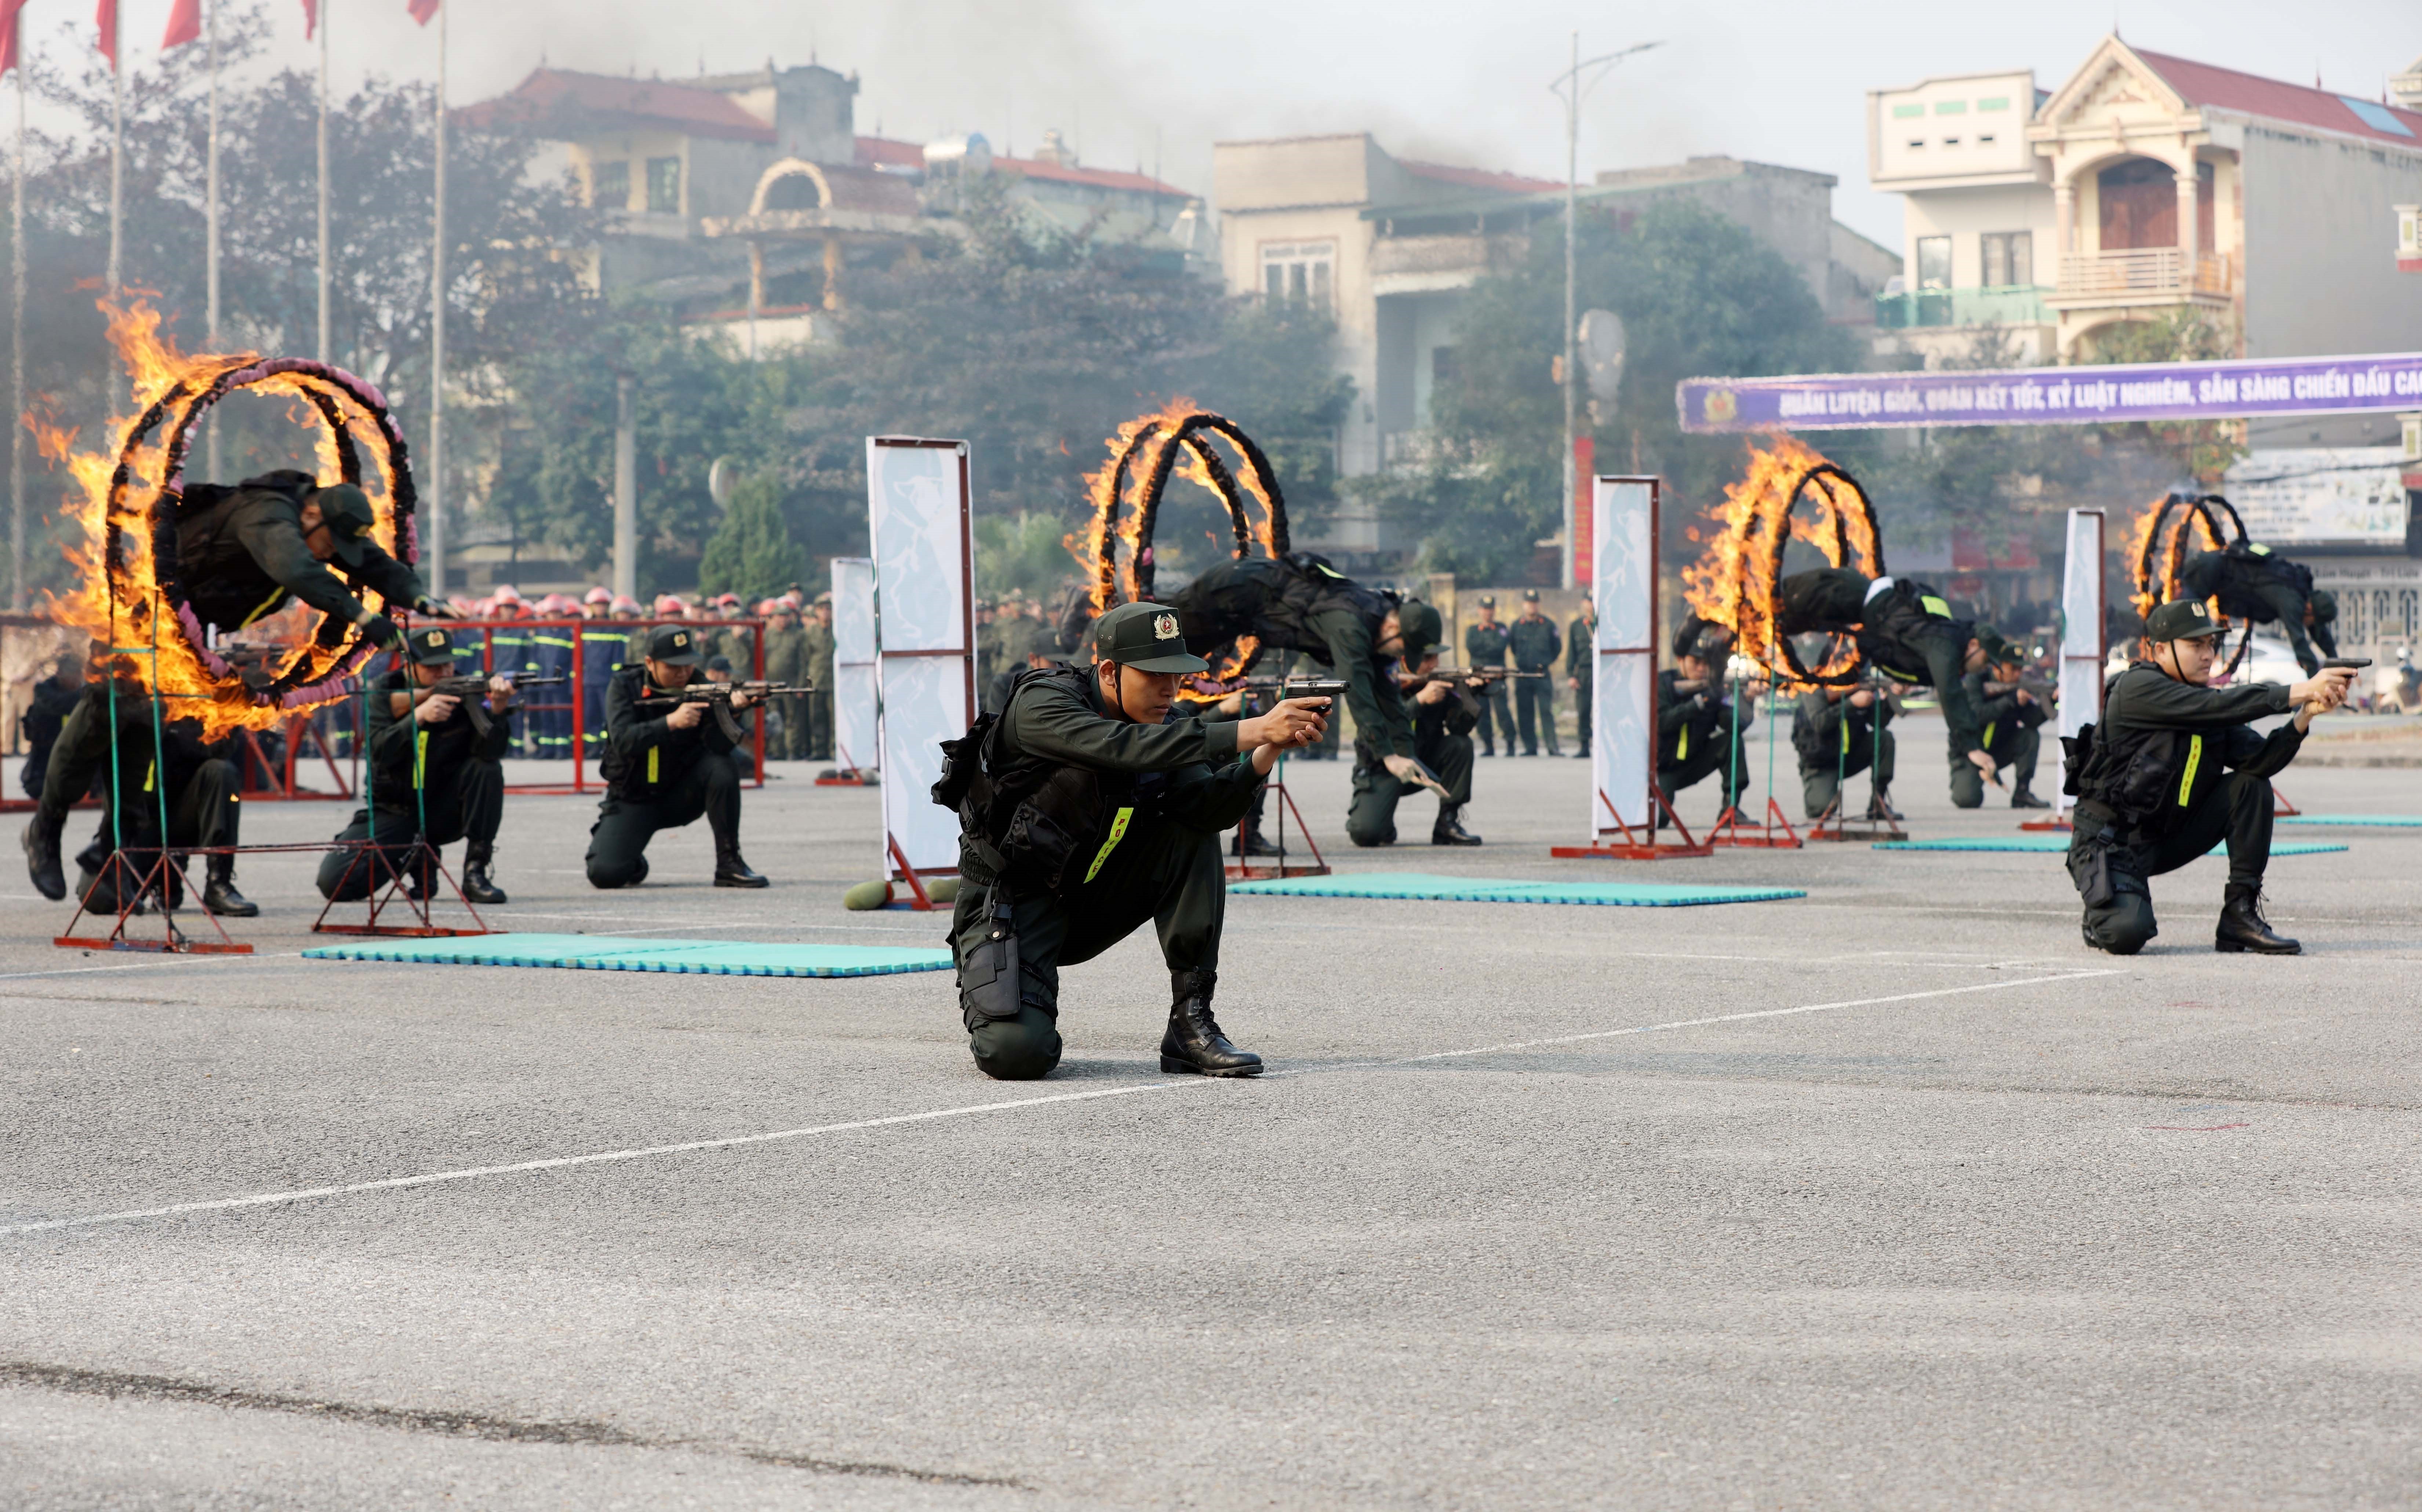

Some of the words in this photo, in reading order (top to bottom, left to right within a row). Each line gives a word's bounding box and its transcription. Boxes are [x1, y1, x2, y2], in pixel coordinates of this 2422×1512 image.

[2047, 378, 2072, 409] KỶ
[2074, 379, 2118, 412] LUẬT
[2120, 376, 2196, 407] NGHIÊM,
[2199, 371, 2237, 403] SẴN
[2240, 372, 2291, 401] SÀNG
[2294, 367, 2350, 399] CHIẾN
[2352, 365, 2391, 397] ĐẤU
[2394, 370, 2422, 395] CA
[1092, 819, 1125, 872] POLICE
